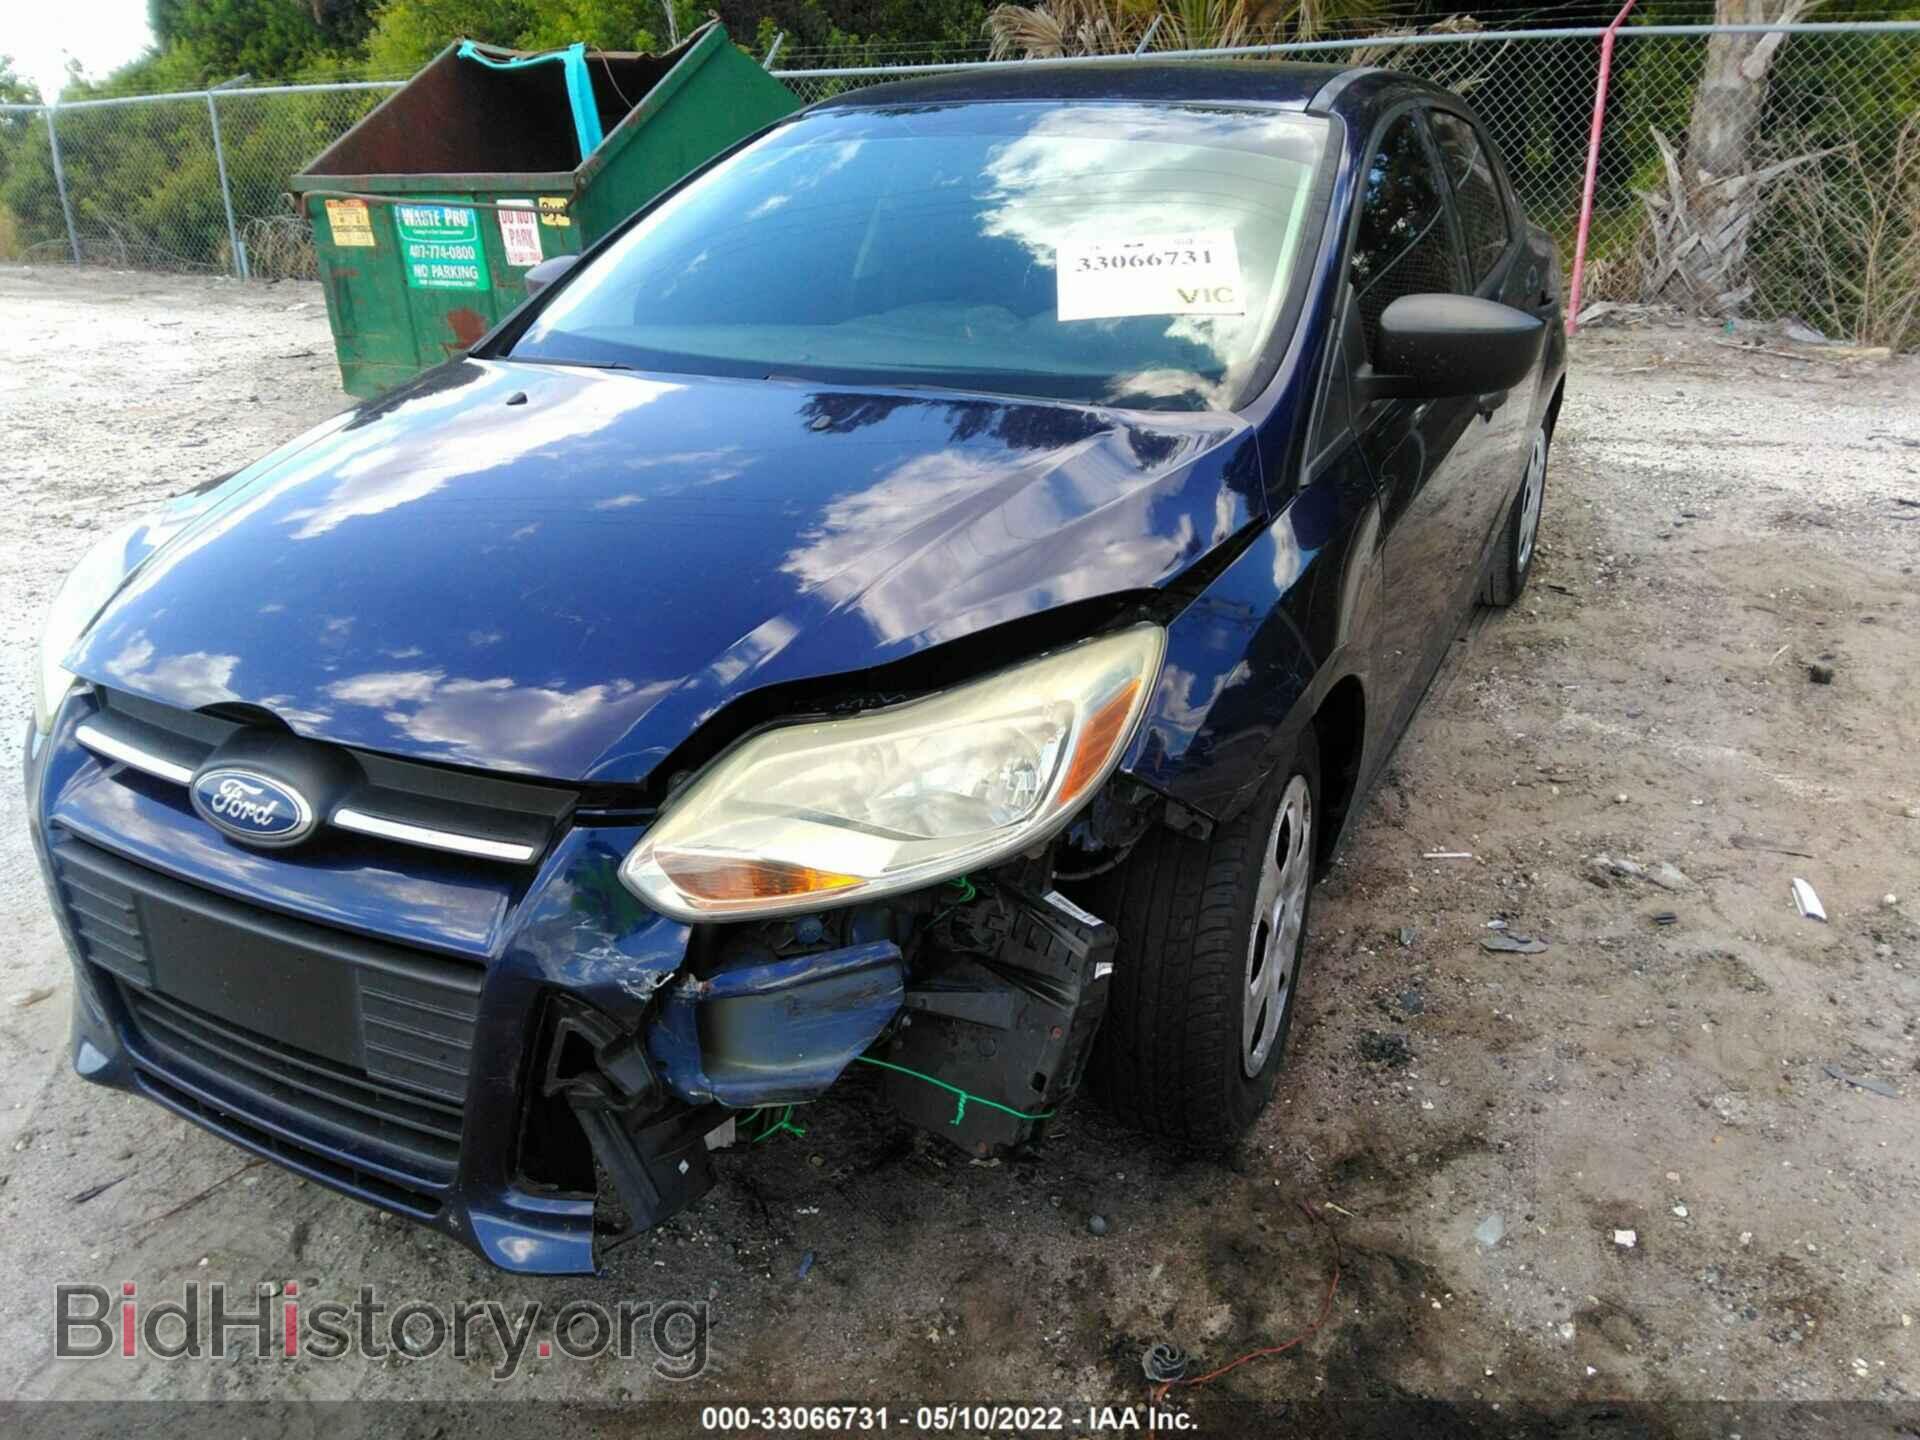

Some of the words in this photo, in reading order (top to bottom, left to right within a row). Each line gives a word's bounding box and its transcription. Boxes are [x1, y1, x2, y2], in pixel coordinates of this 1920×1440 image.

[400, 207, 441, 227] WASTE
[444, 207, 469, 228] PRO
[500, 206, 514, 224] DO
[516, 206, 534, 224] NOT
[508, 228, 536, 248] PARK
[1076, 250, 1212, 273] 33066731
[413, 264, 428, 278] NO
[431, 264, 479, 280] PARKING
[1176, 286, 1234, 304] VIC
[211, 778, 279, 826] Ford
